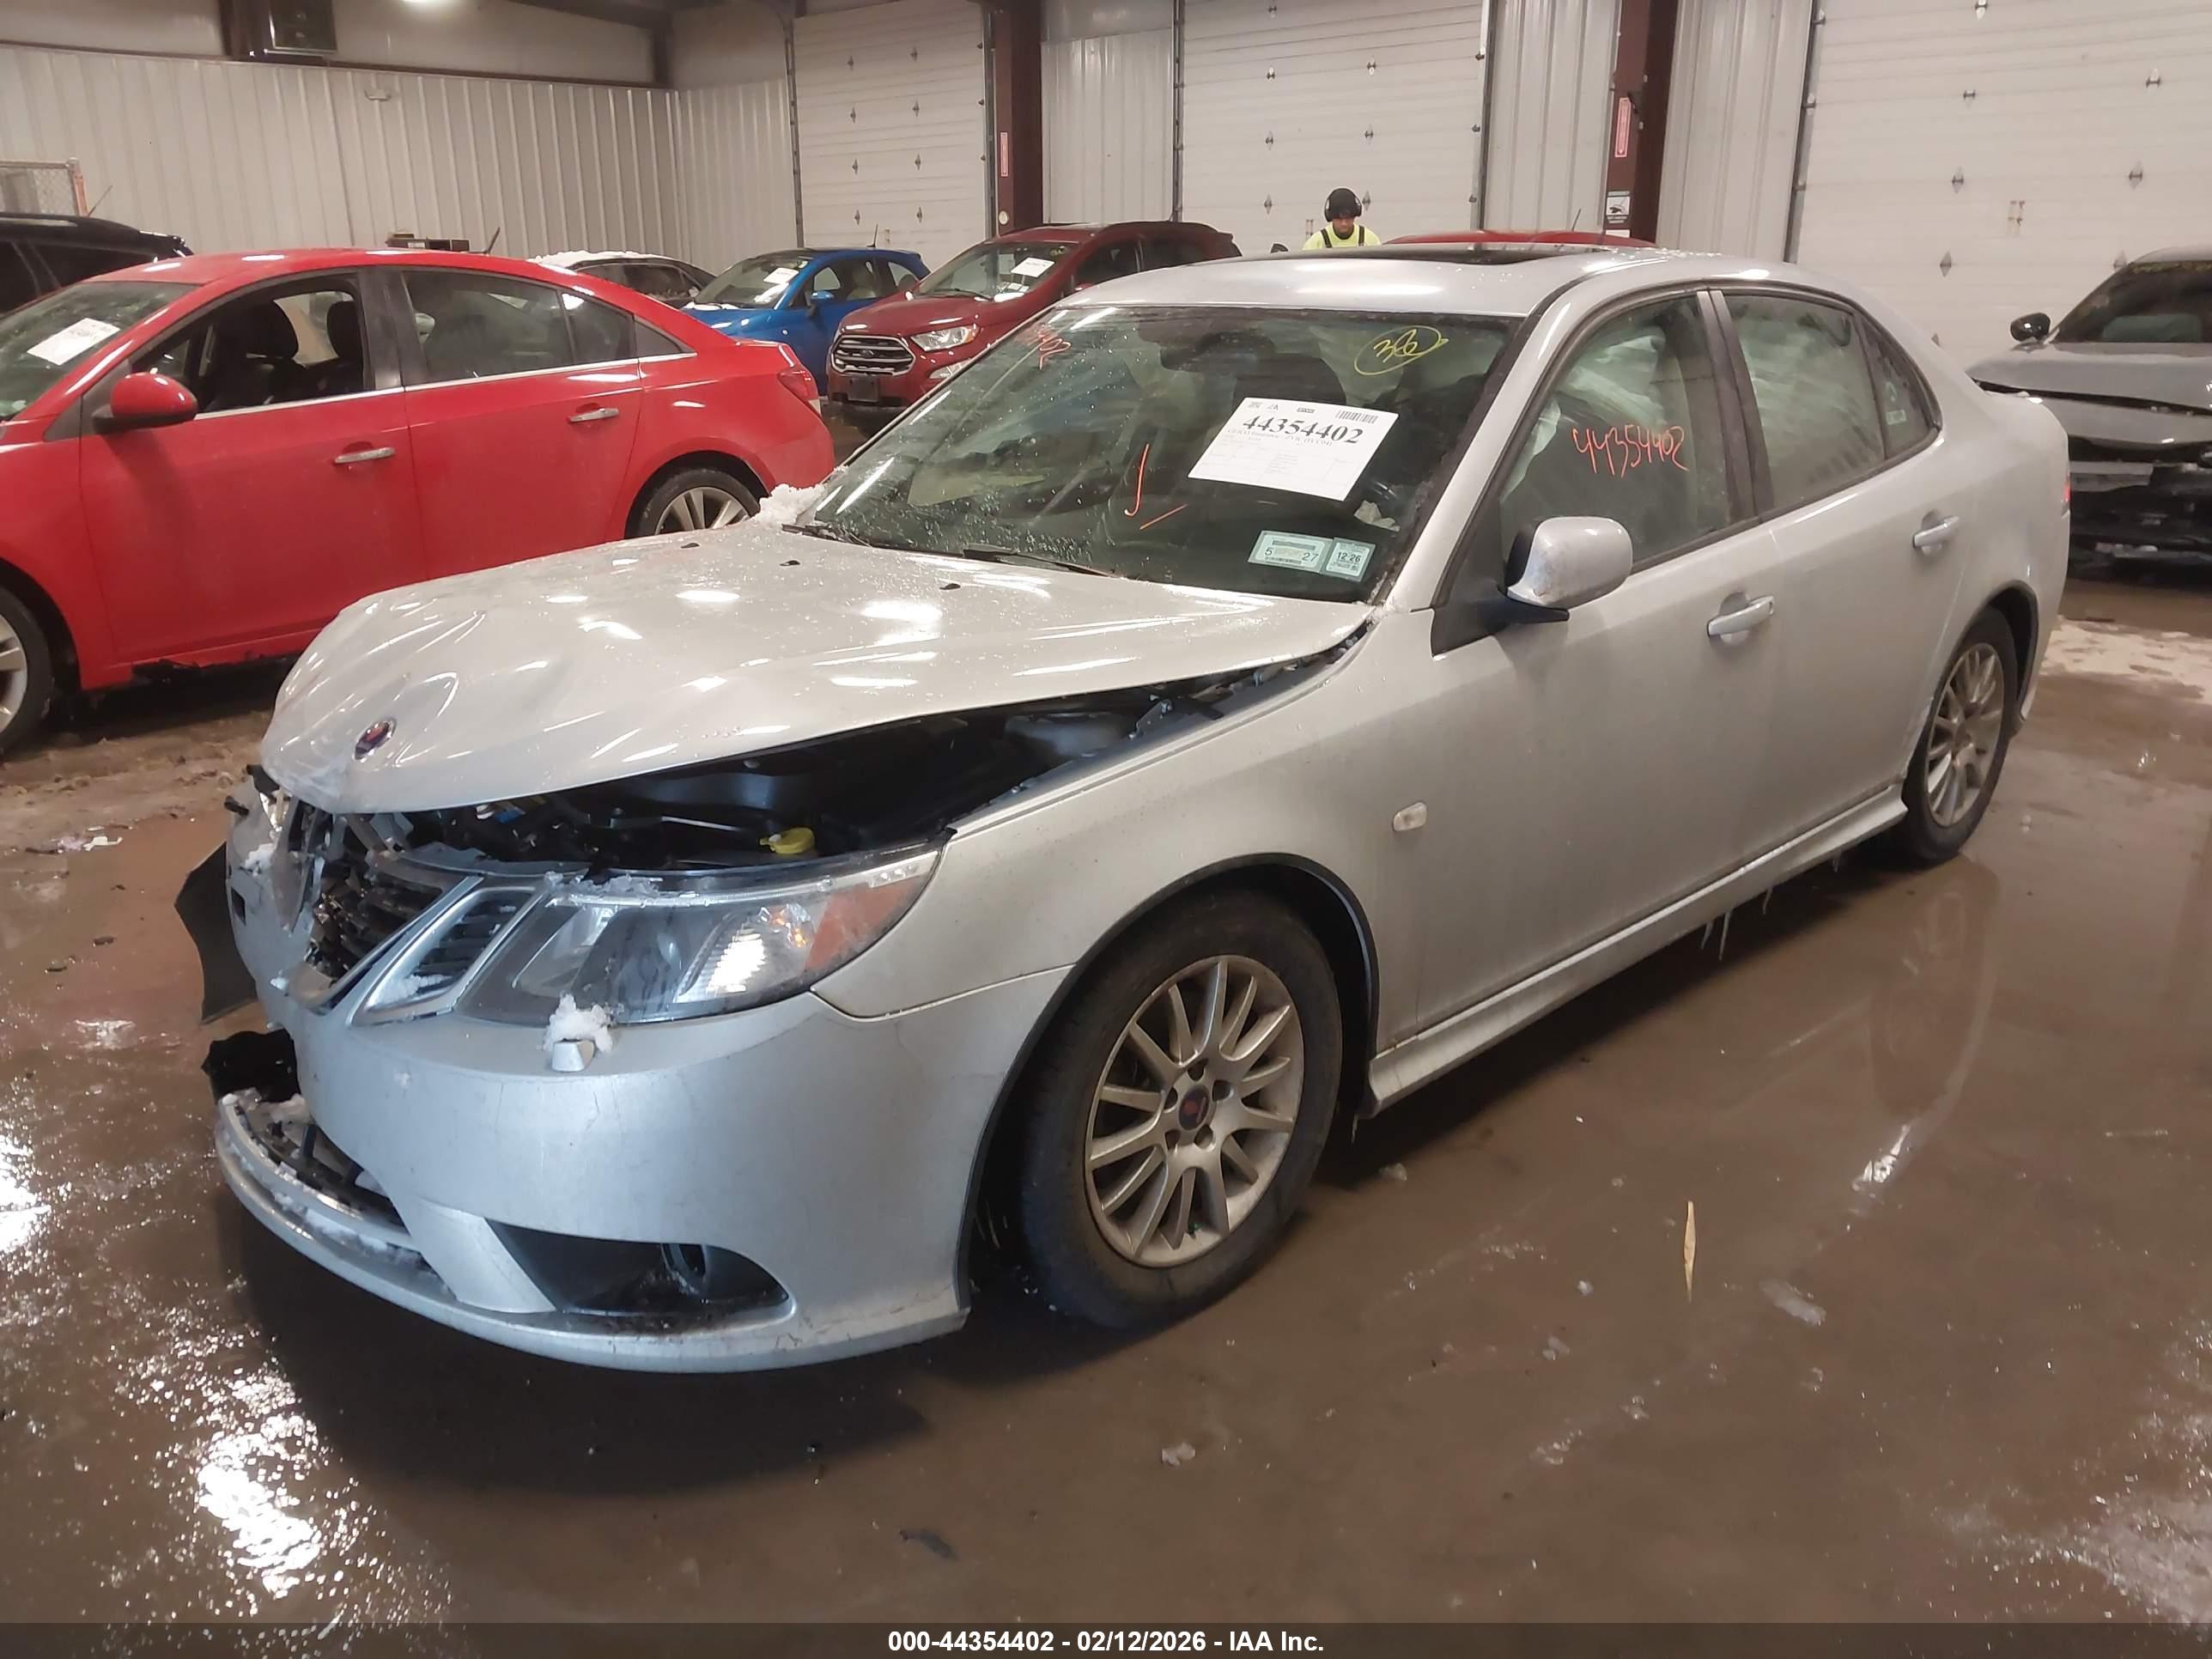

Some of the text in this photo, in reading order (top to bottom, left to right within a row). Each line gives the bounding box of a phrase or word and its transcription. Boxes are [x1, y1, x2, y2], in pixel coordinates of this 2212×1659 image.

[1243, 415, 1364, 444] 44354402
[1264, 547, 1273, 556] 5
[1301, 552, 1320, 562] 27
